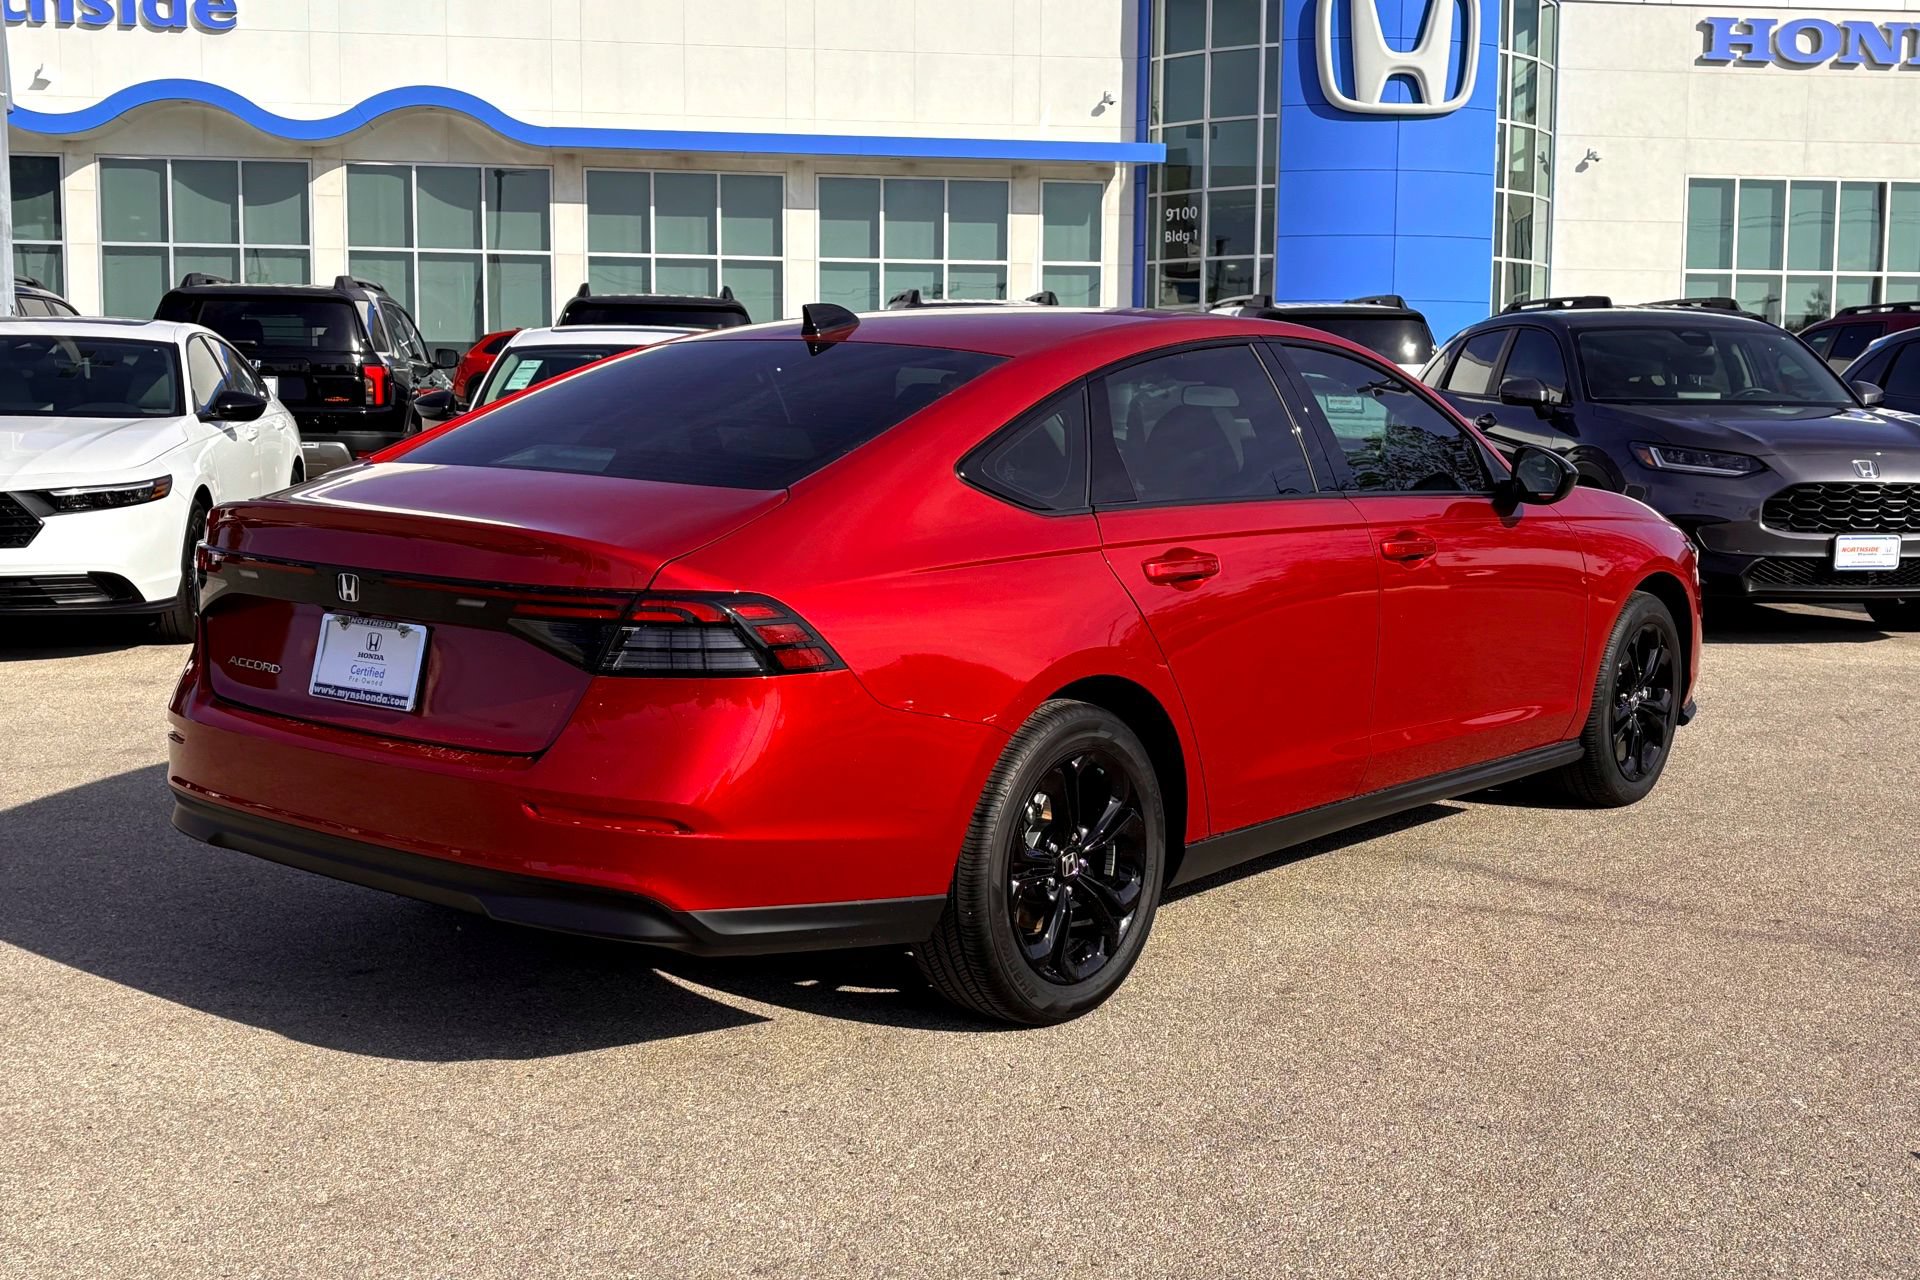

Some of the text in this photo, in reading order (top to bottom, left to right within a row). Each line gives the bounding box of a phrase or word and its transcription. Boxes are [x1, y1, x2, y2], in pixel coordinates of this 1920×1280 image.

[1166, 206, 1198, 222] 9100
[1165, 229, 1198, 244] Bldg 1
[351, 617, 397, 629] NORTHSIDE
[358, 651, 384, 661] HONDA
[228, 655, 281, 674] ACCORD
[350, 665, 385, 679] Certified
[313, 684, 409, 707] www.mynshonda.com
